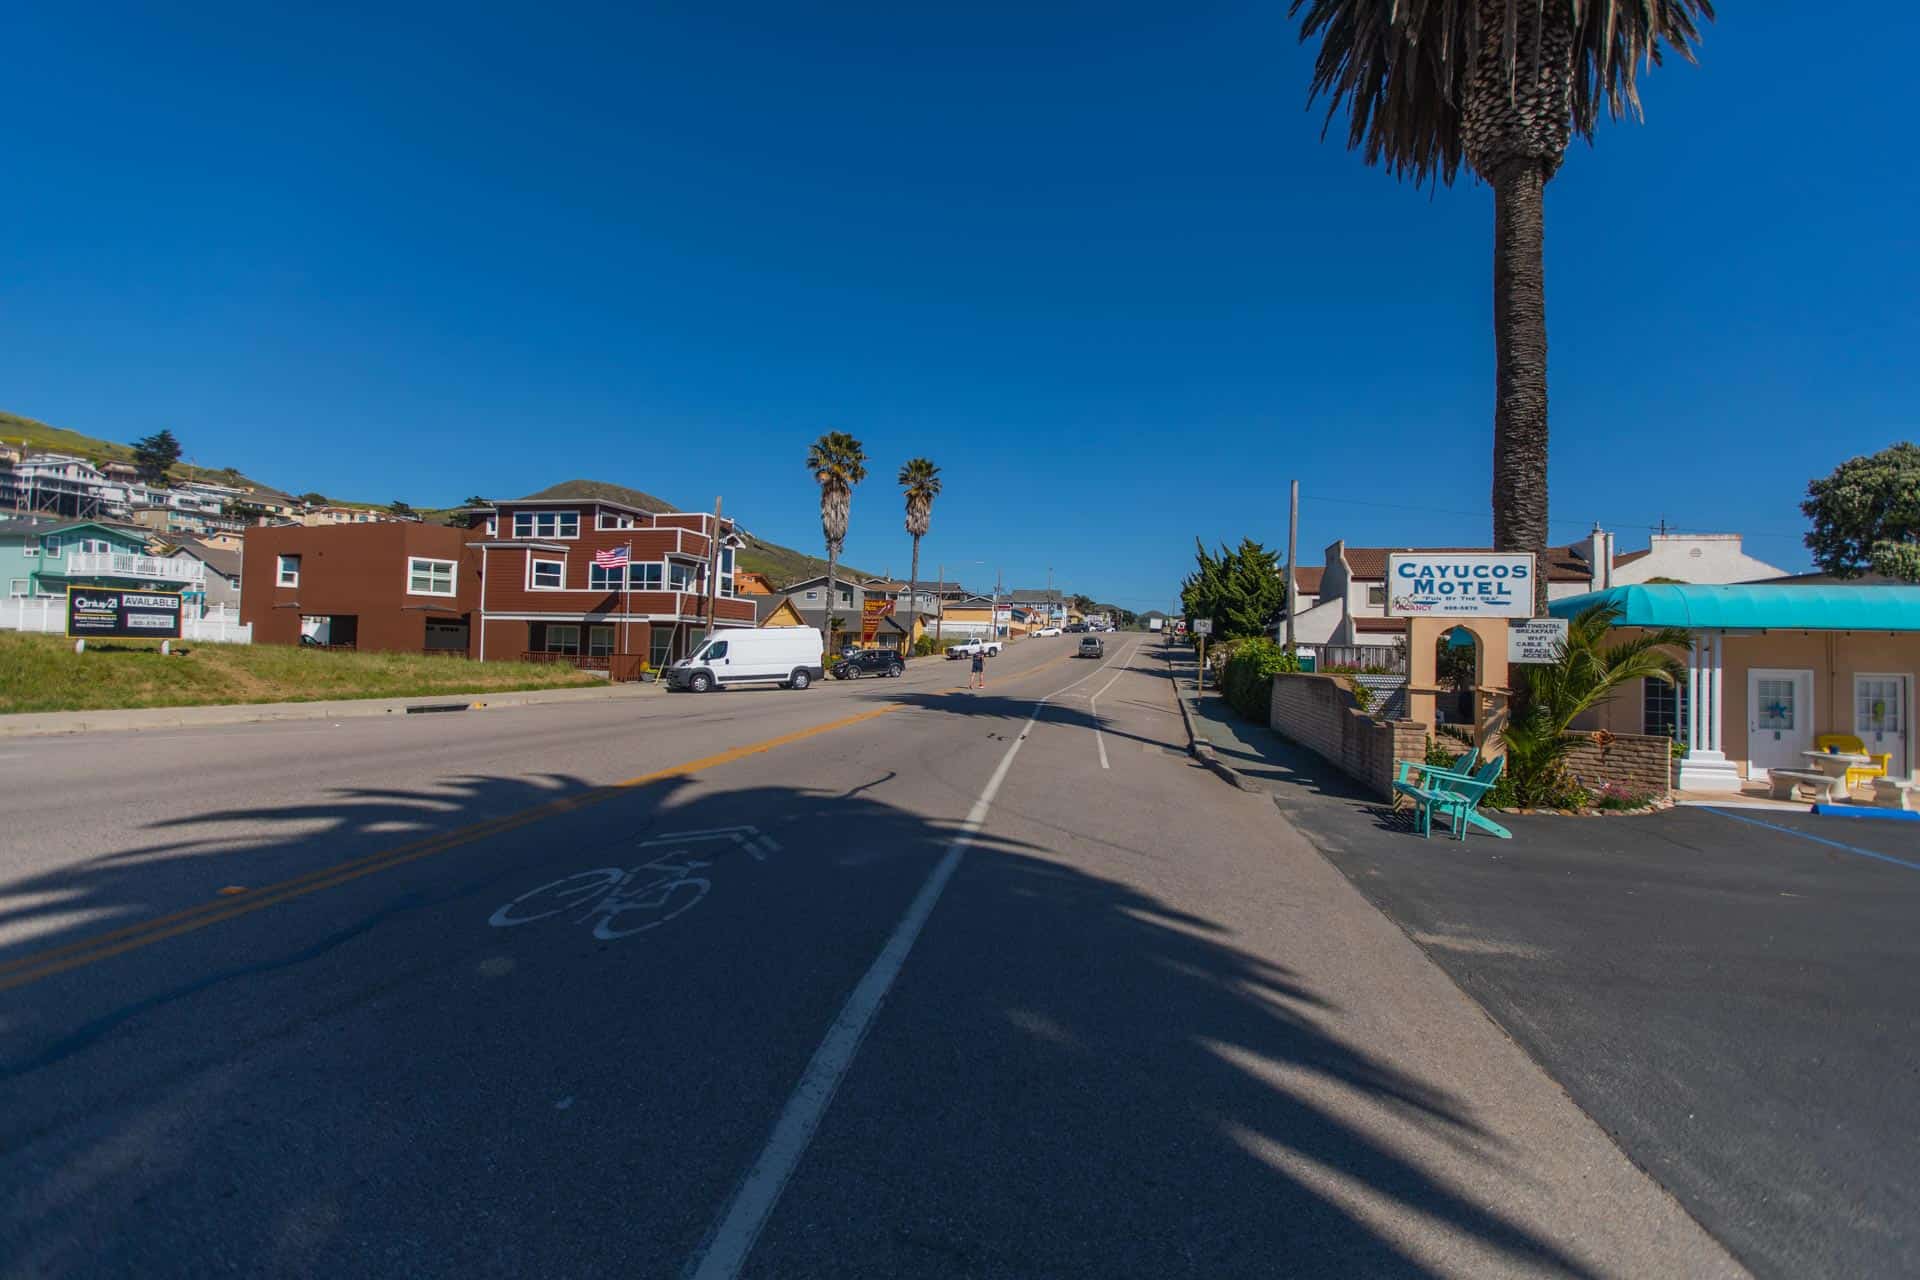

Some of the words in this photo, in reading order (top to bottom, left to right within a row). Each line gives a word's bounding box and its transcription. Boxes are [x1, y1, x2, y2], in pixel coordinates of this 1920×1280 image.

[1398, 562, 1528, 579] CAYUCOS
[1414, 579, 1512, 595] MOTEL
[125, 597, 178, 608] AVAILABLE
